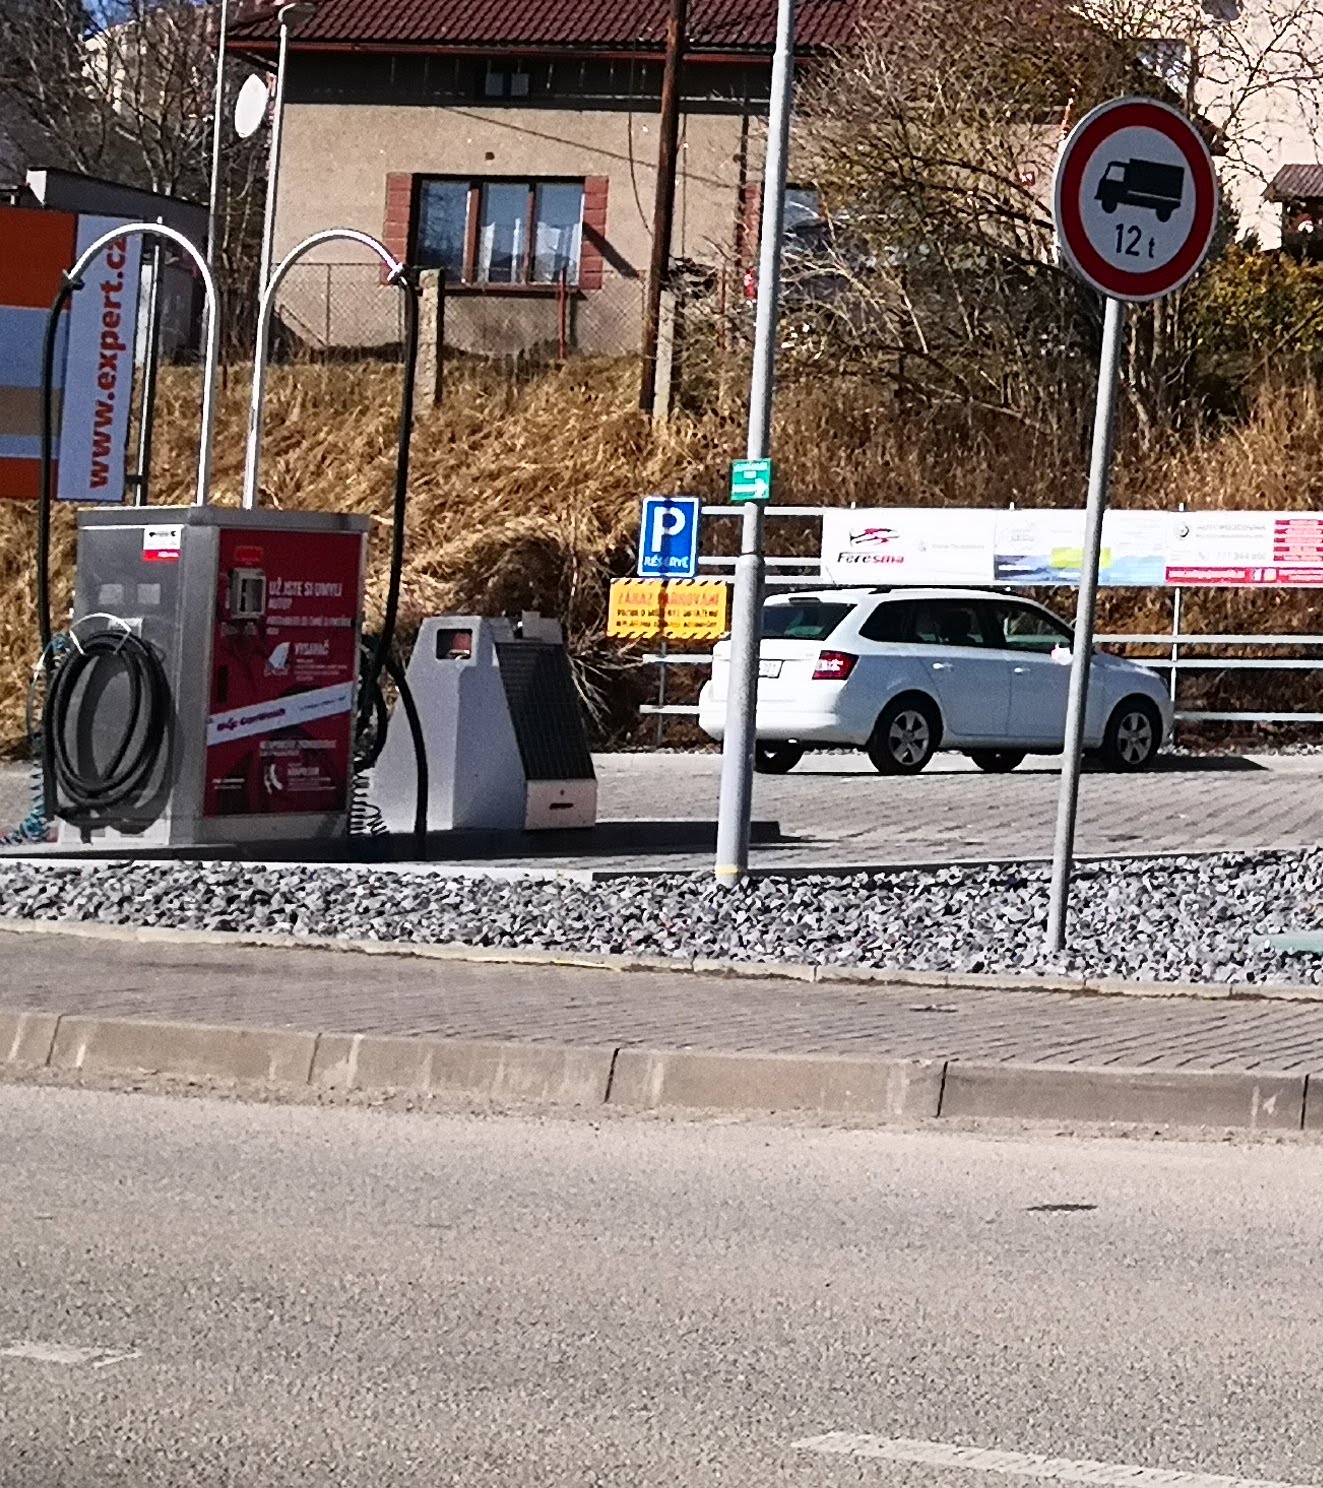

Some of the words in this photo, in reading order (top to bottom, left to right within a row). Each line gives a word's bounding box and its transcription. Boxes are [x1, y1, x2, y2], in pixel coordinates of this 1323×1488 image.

[1115, 223, 1142, 257] 12
[1148, 237, 1155, 259] t
[651, 506, 686, 553] P
